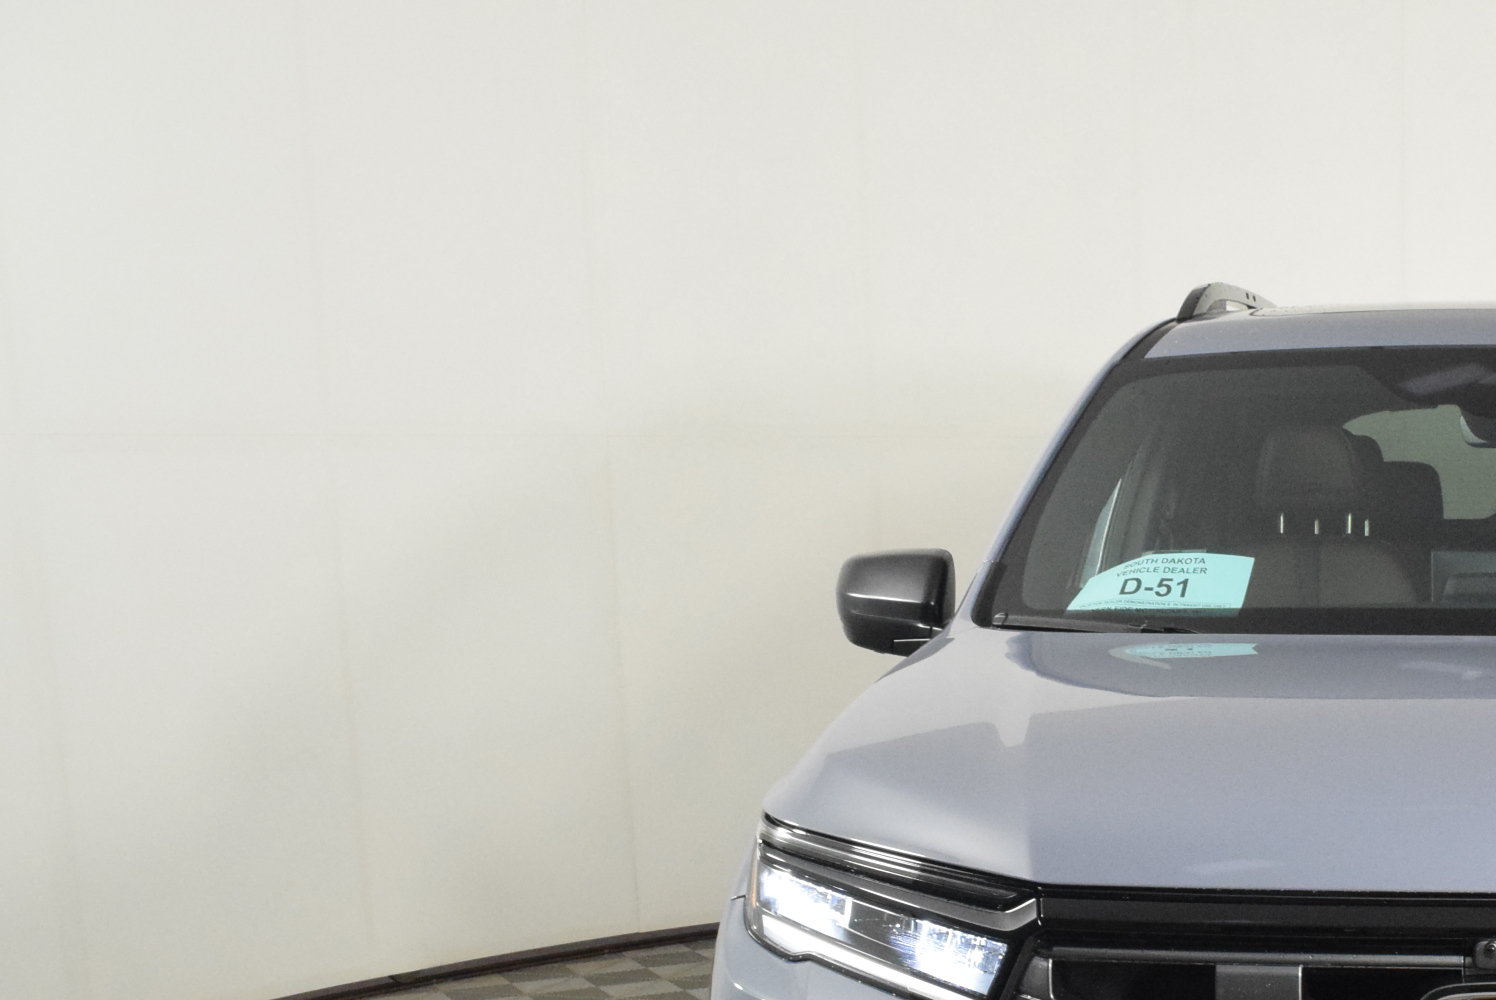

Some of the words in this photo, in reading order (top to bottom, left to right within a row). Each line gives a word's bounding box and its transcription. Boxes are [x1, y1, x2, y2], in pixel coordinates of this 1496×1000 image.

[1124, 558, 1158, 569] SOUTH
[1161, 557, 1206, 565] DAKOTA
[1116, 566, 1160, 577] VEHICLE
[1163, 566, 1208, 575] DEALER
[1119, 577, 1190, 598] D-51
